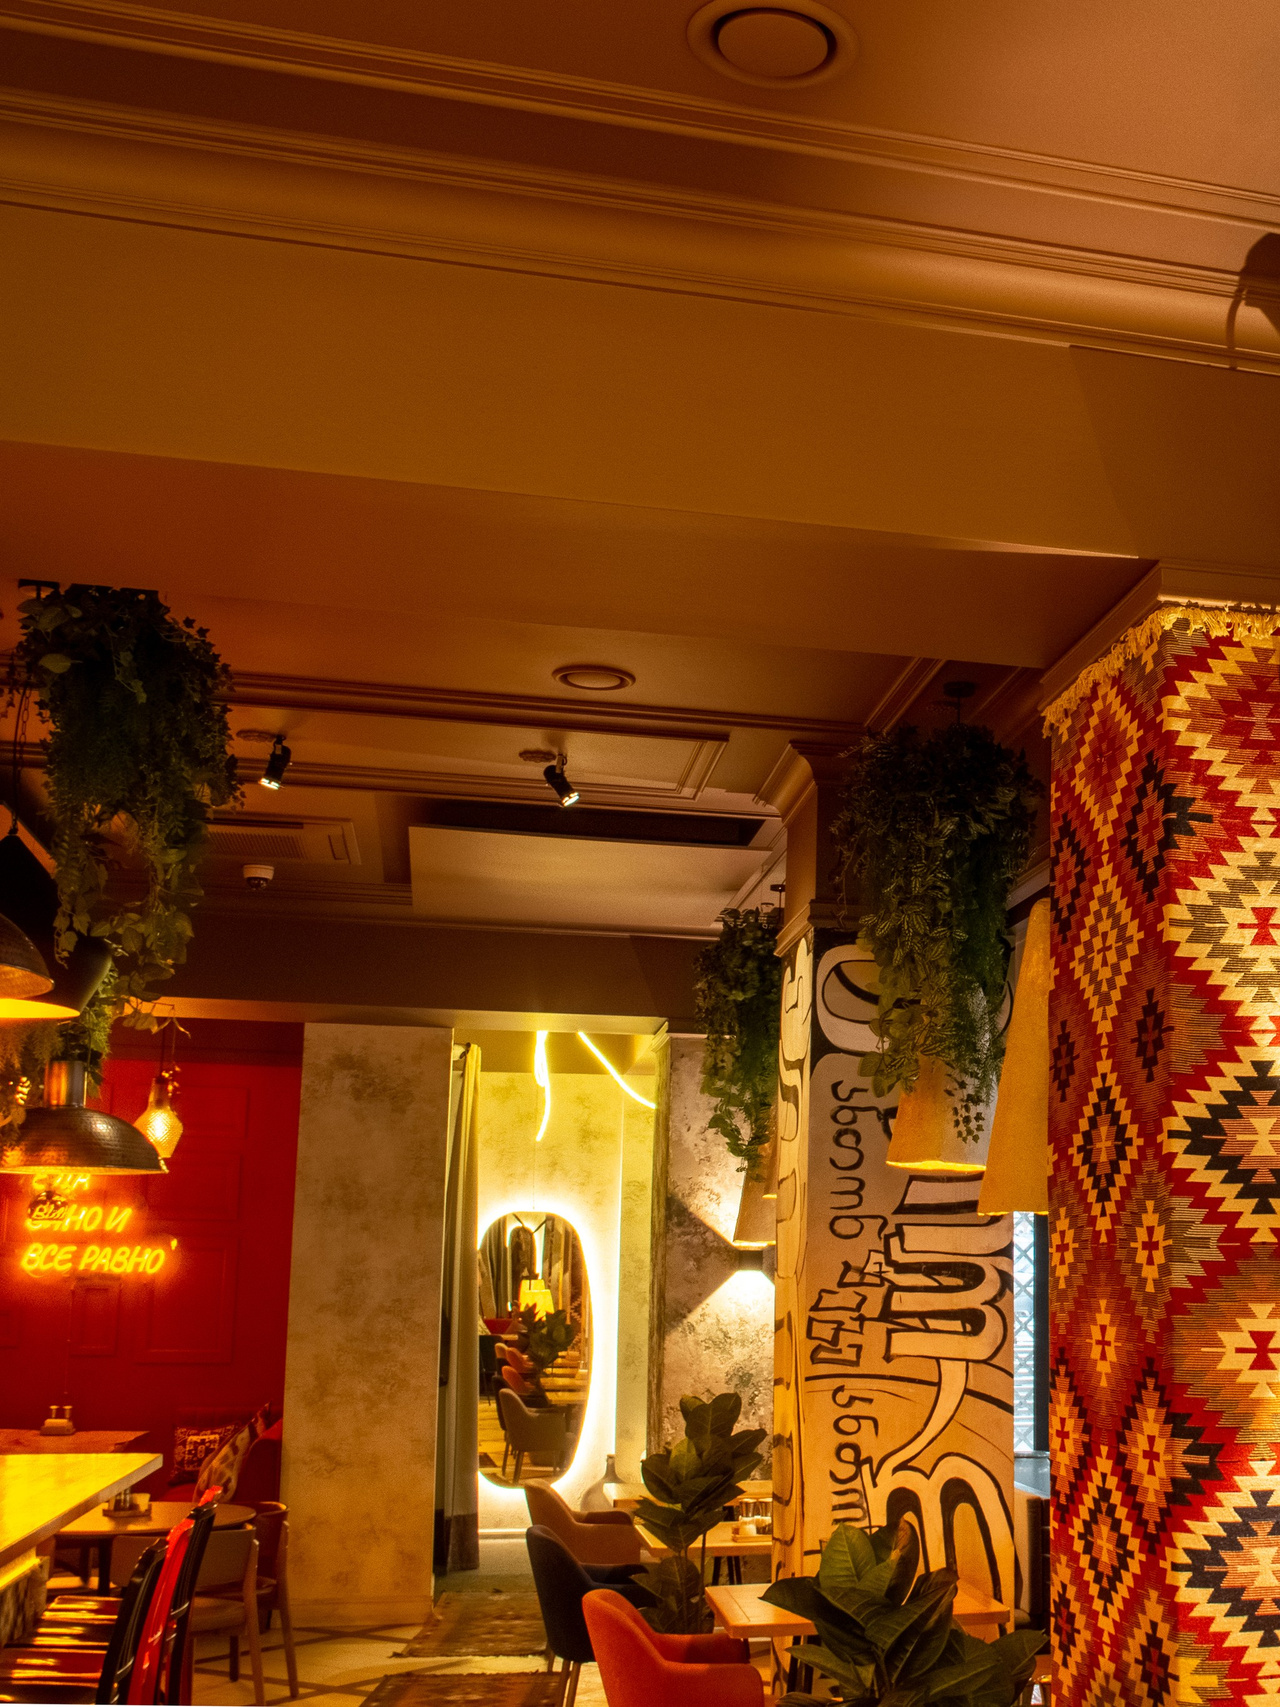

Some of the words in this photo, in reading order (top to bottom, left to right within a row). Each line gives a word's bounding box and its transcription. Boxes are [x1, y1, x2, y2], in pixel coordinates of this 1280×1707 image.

[105, 1205, 133, 1233] И
[21, 1242, 78, 1271] ВСЕ
[79, 1244, 166, 1274] РАВНО
